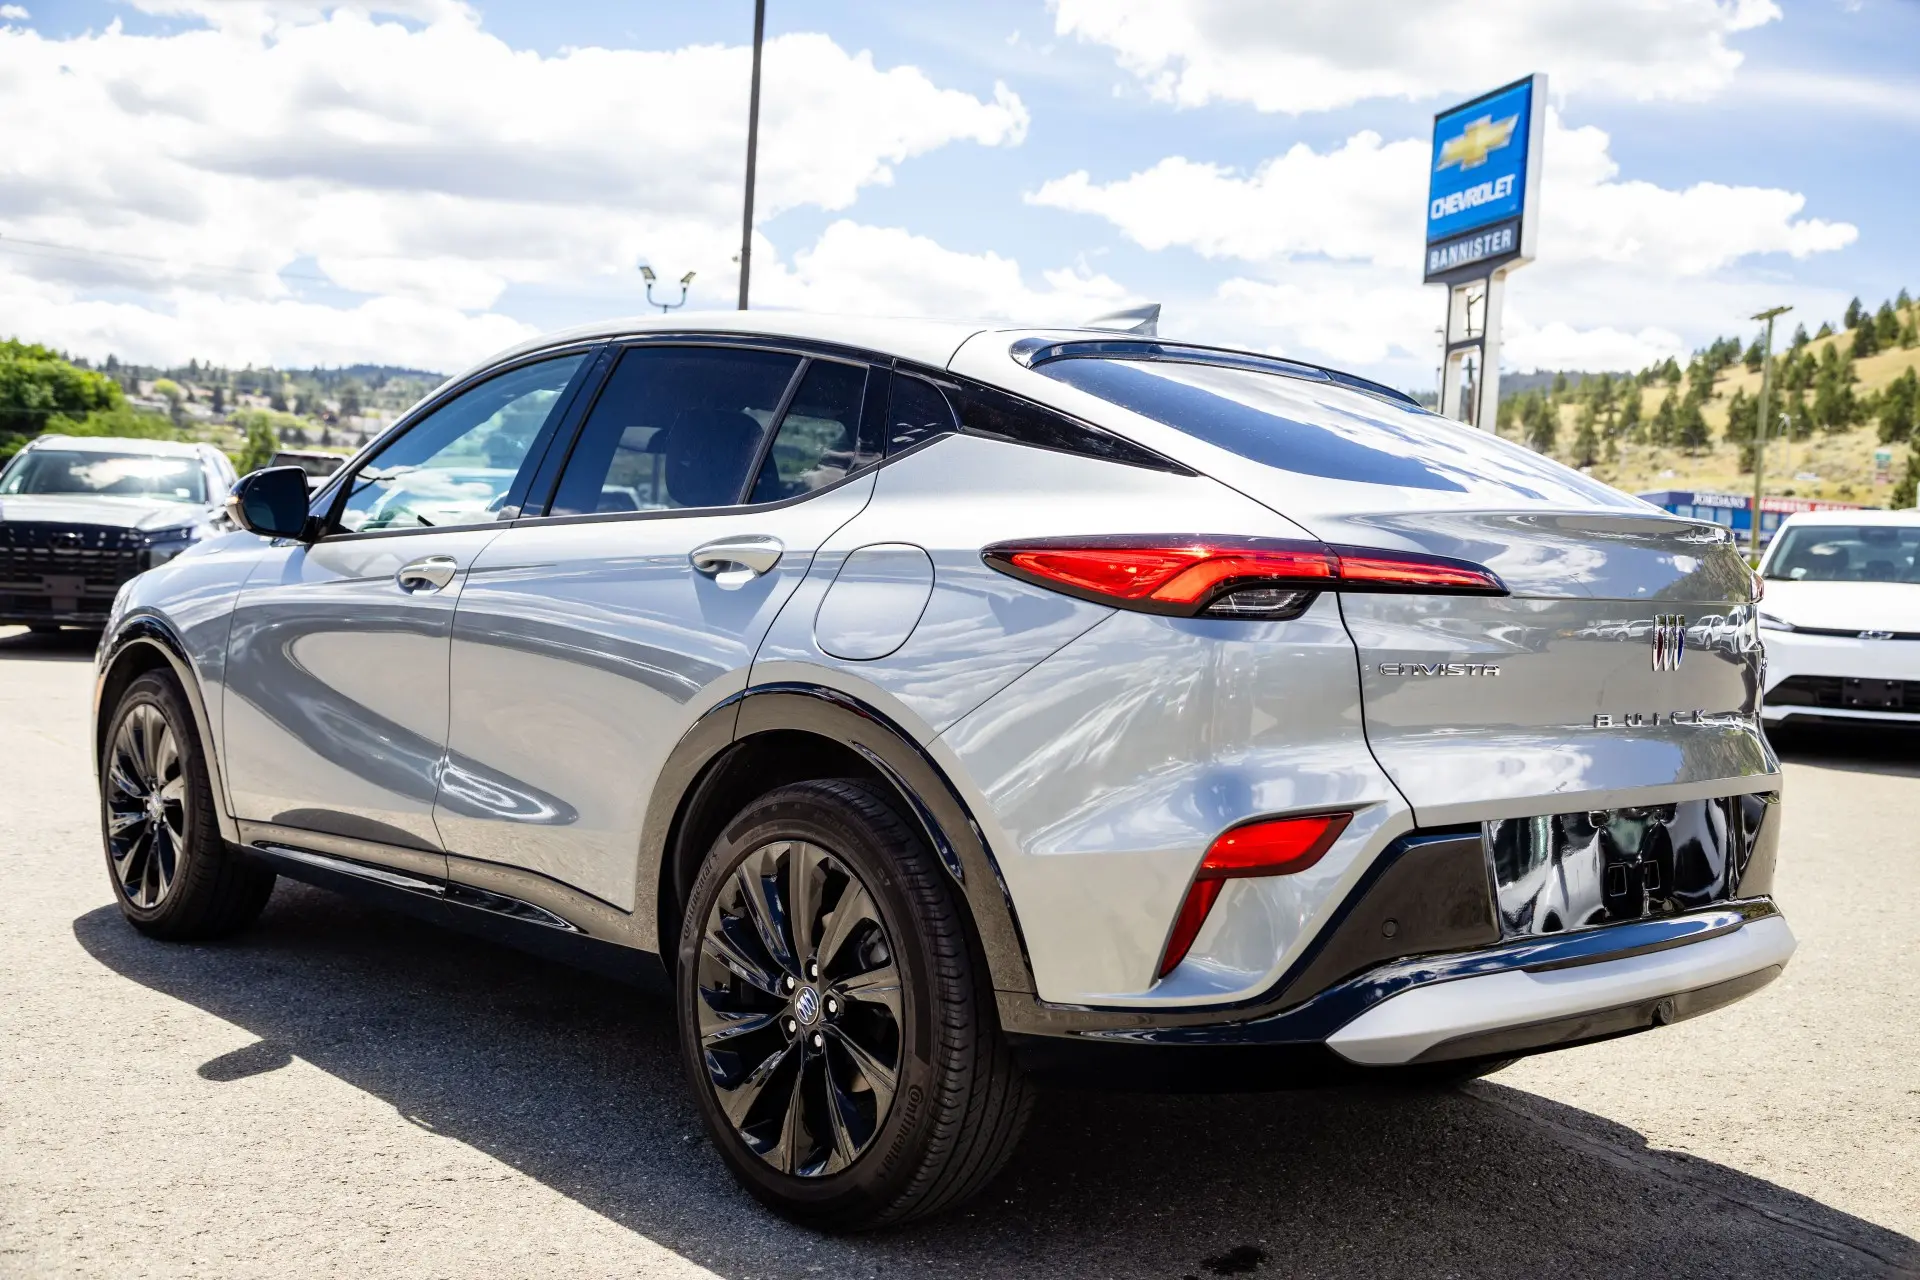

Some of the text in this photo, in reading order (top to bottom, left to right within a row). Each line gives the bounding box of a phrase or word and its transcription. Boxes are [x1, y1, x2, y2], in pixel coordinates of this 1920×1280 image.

[1430, 174, 1515, 220] CHEVROLET
[1430, 228, 1511, 270] BANNISTER
[1379, 663, 1500, 677] ENVISTA
[1594, 709, 1706, 729] BUICK
